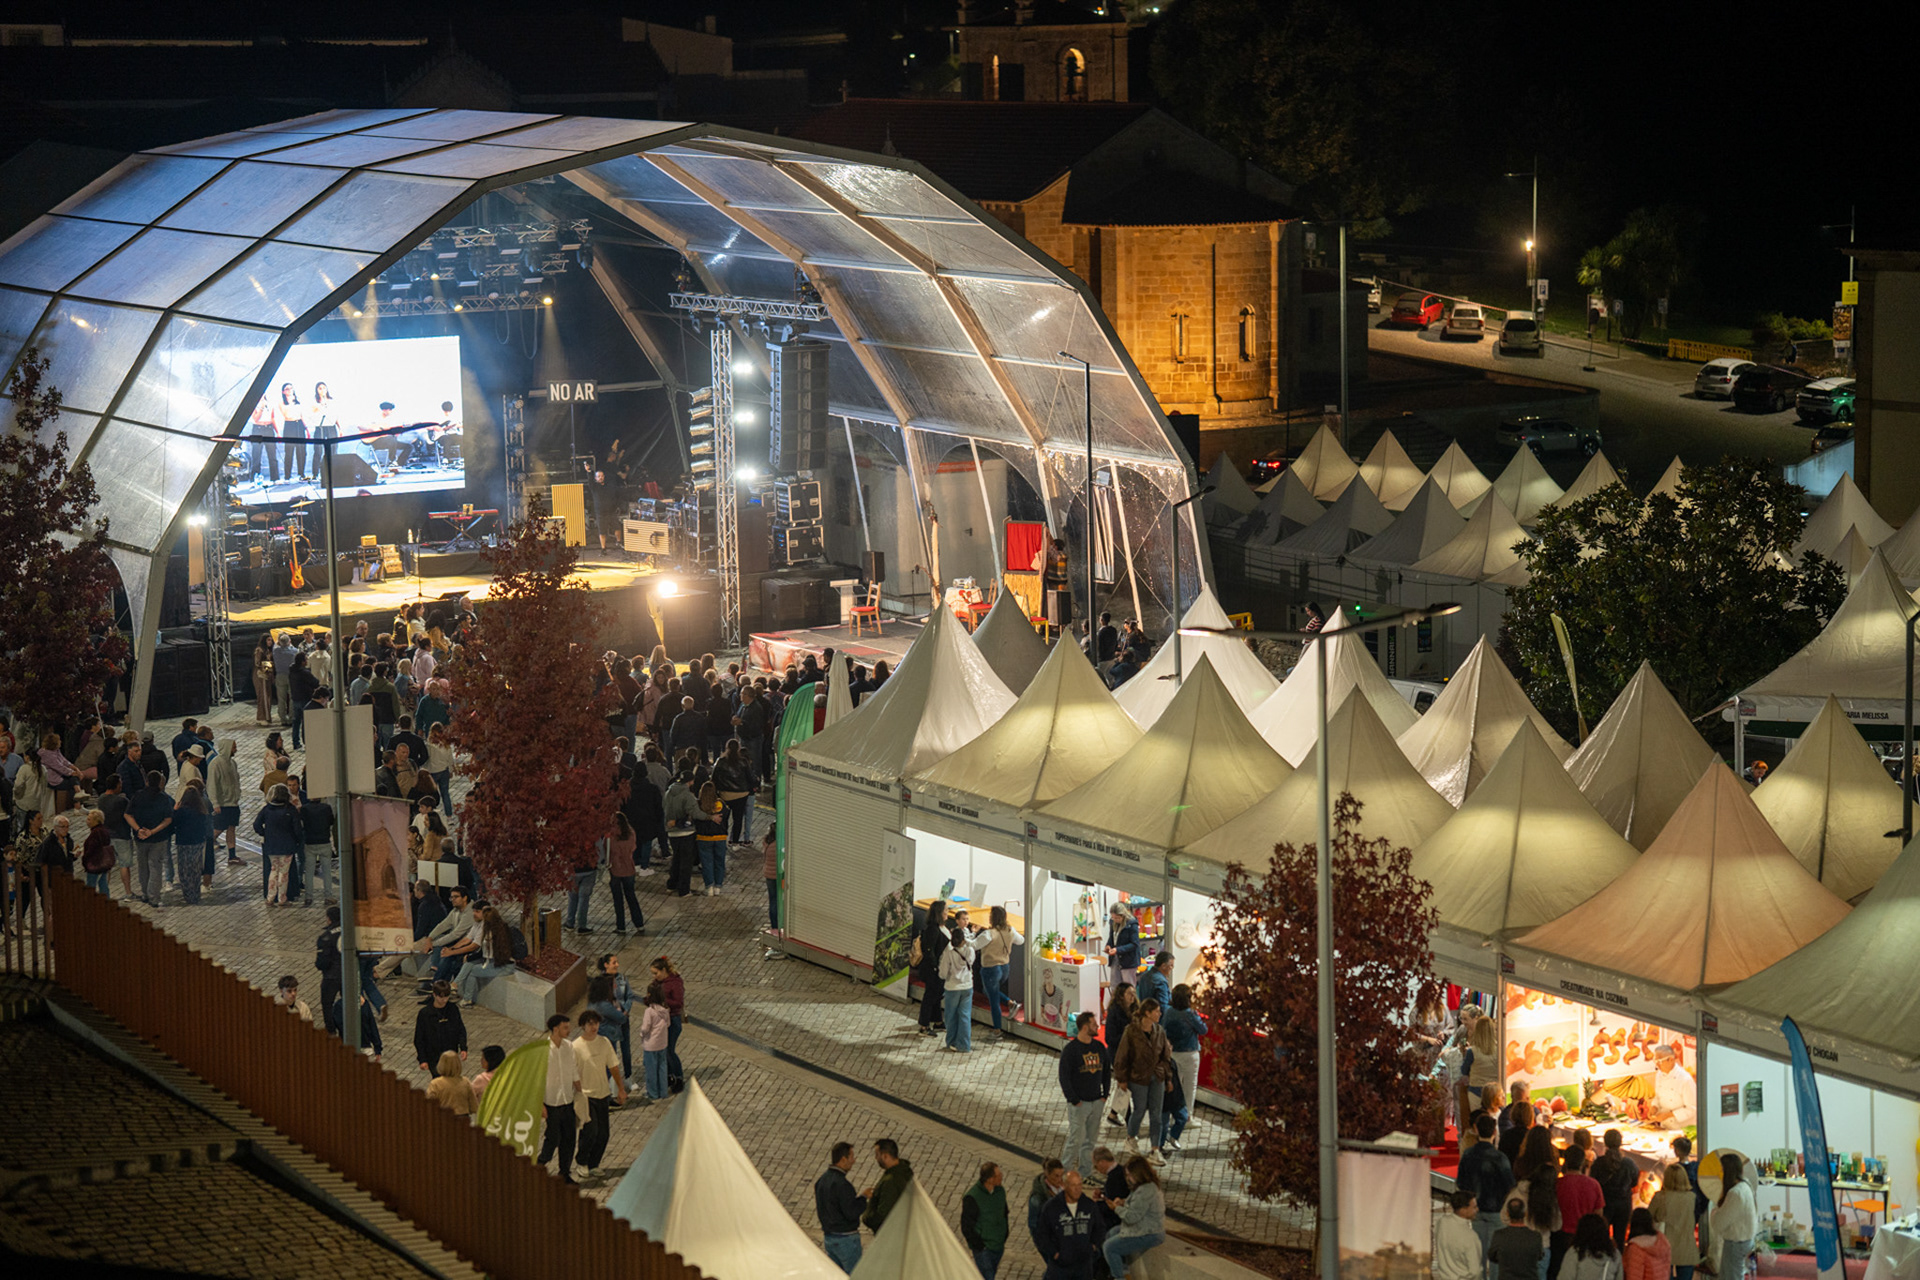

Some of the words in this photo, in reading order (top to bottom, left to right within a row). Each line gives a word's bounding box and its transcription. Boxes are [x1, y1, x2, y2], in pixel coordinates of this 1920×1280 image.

[550, 383, 570, 401] NO
[574, 383, 595, 401] AR
[1862, 711, 1888, 720] MELISSA
[1560, 979, 1595, 997] CREATIVIDADE
[1595, 989, 1604, 999] NA
[1605, 991, 1629, 1006] COZINHA
[1813, 1047, 1839, 1062] CHOGAN
